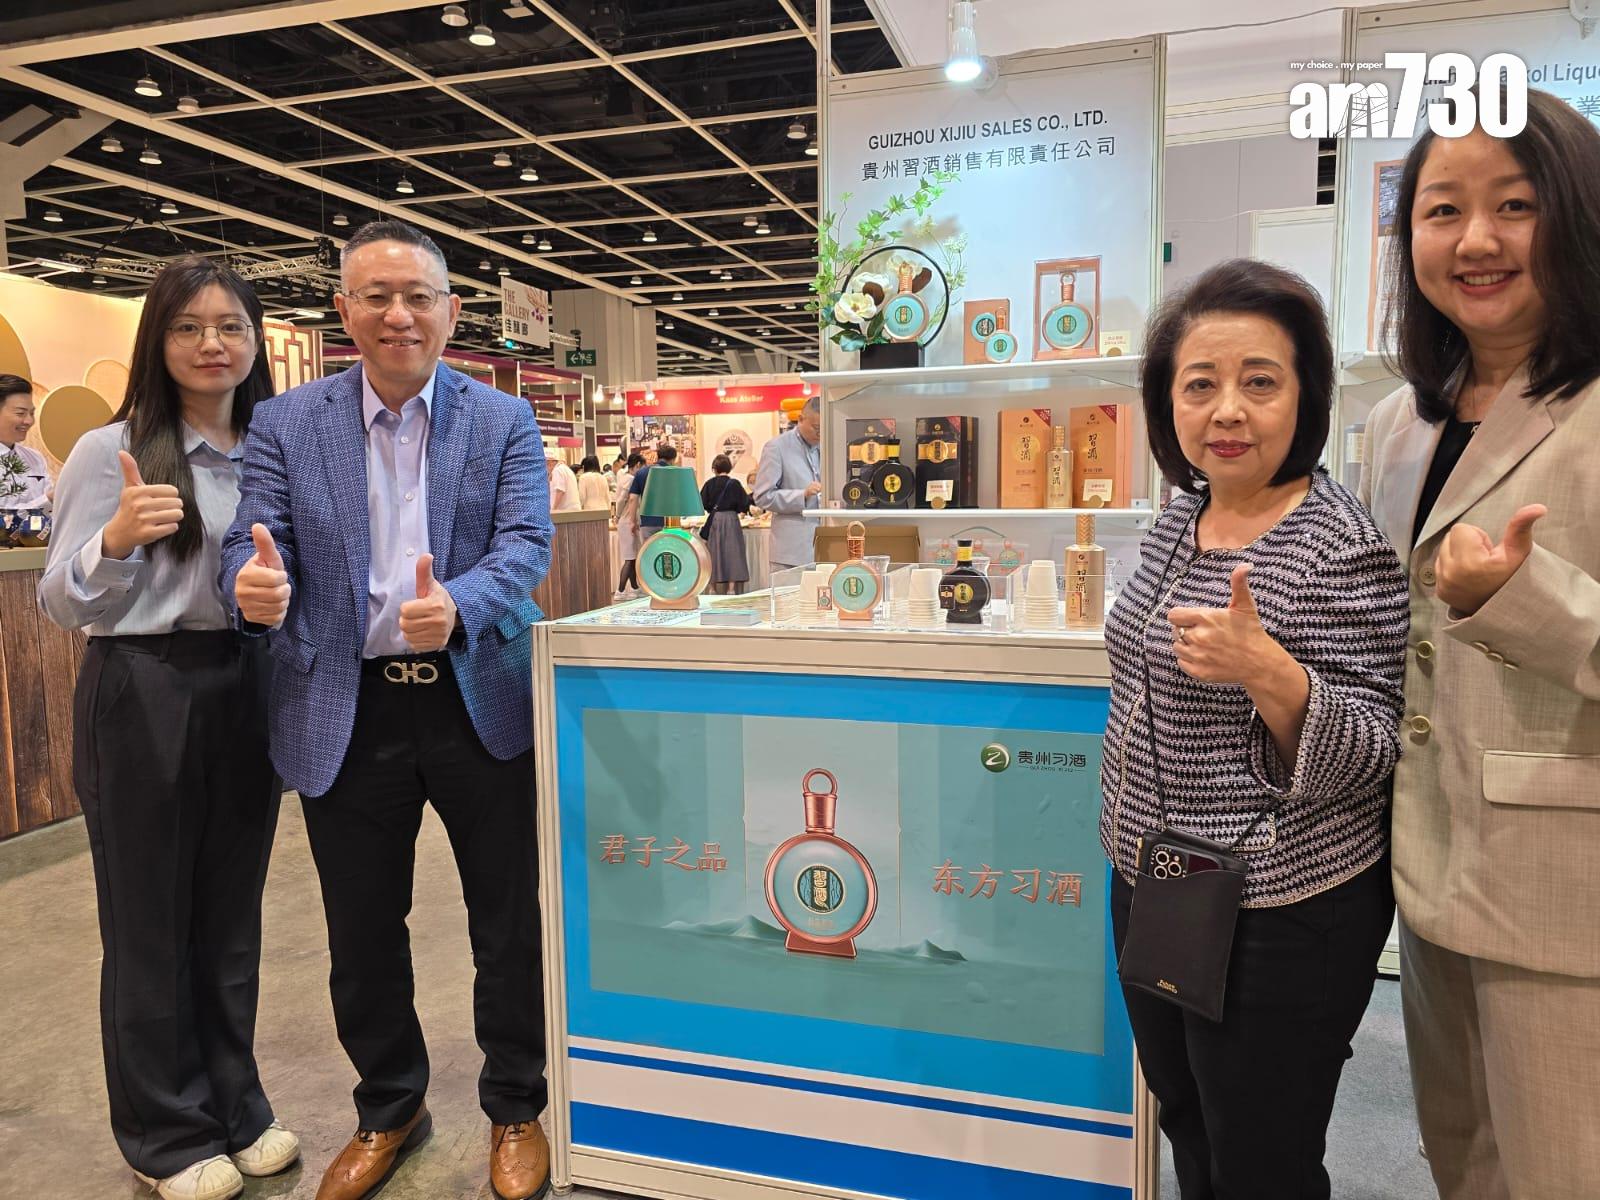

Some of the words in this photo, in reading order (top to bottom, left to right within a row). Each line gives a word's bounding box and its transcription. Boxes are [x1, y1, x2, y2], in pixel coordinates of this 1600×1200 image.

[1554, 63, 1600, 85] Liqu
[868, 129, 935, 150] GUIZHOU
[939, 124, 976, 143] XIJIU
[981, 118, 1032, 138] SALES
[1037, 114, 1069, 132] CO.,
[1074, 109, 1108, 128] LTD.
[862, 136, 1115, 181] 貴州習酒銷售有限責任公司
[504, 288, 515, 304] THE
[1017, 750, 1087, 768] 贵州习酒
[599, 834, 728, 872] 君子之品
[931, 858, 1084, 908] 东方习酒
